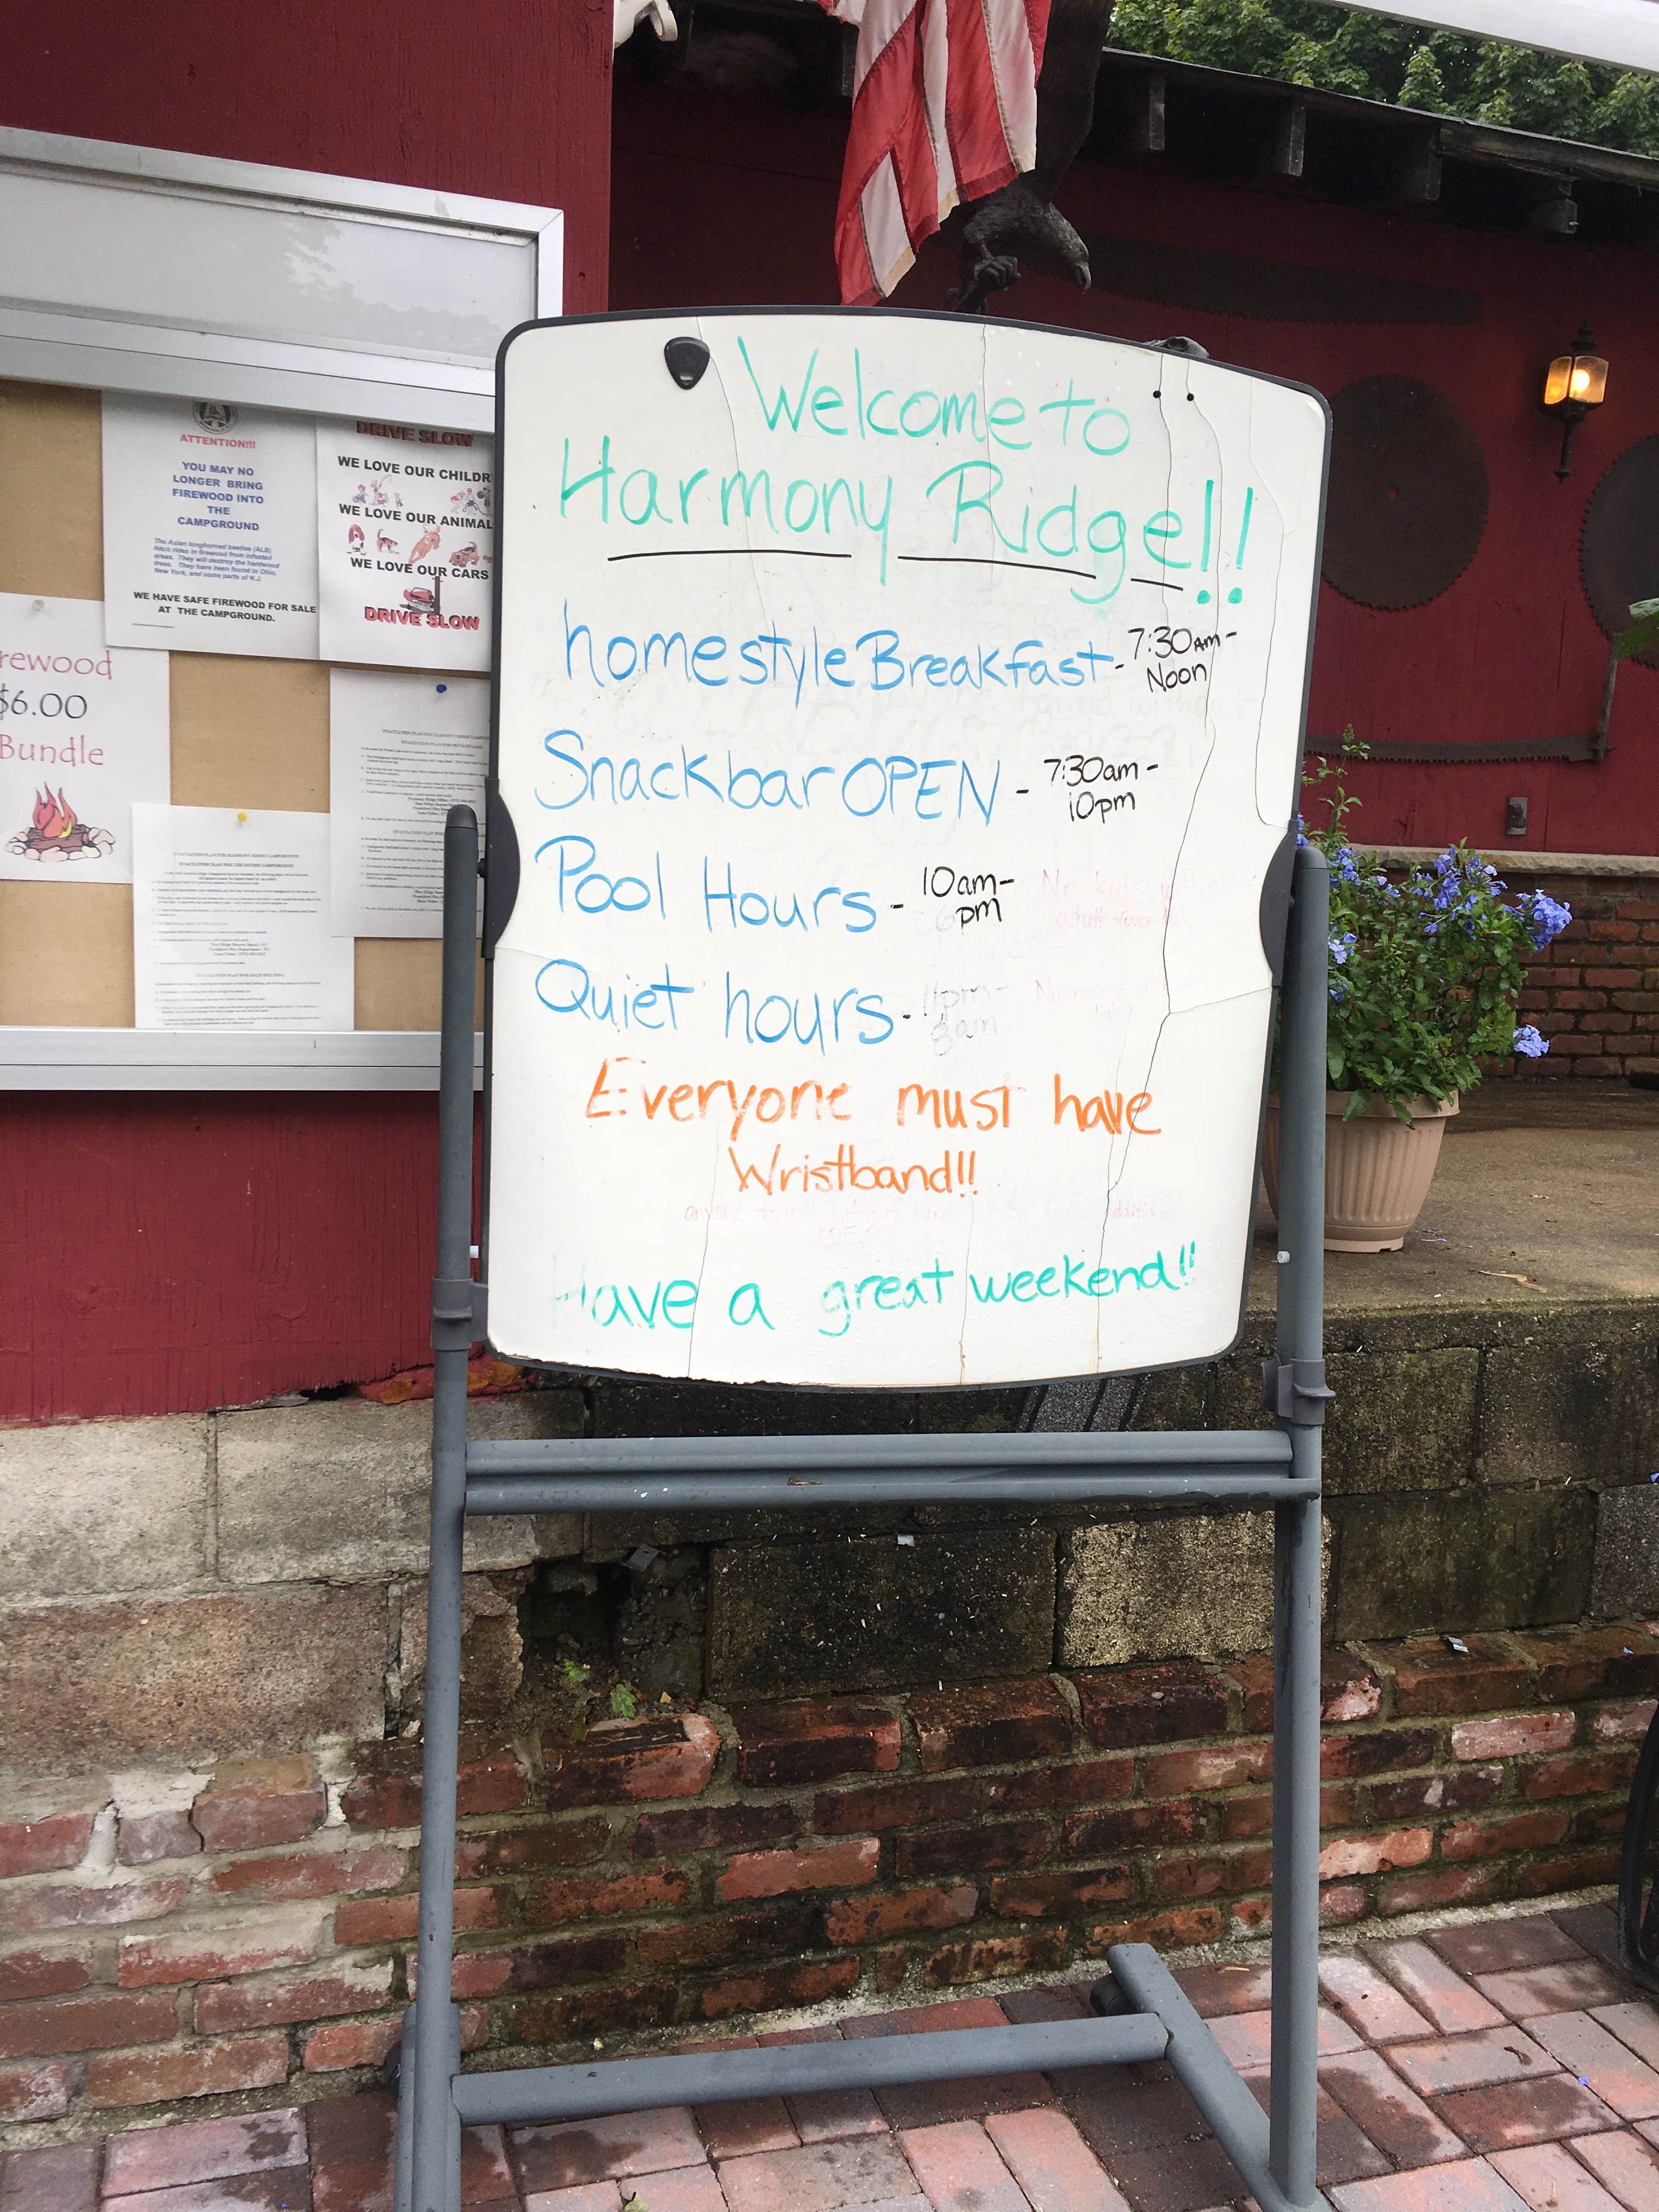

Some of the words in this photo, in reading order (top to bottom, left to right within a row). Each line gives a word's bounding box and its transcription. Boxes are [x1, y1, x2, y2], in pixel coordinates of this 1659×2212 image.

[737, 335, 1032, 450] Welcome
[1040, 379, 1130, 455] to
[179, 433, 256, 449] ATTENTION!!!
[357, 421, 415, 441] DRIVE
[419, 430, 475, 447] SLOW
[182, 461, 206, 472] YOU
[210, 464, 234, 475] MAY
[238, 467, 254, 476] NO
[337, 455, 359, 468] WE
[364, 459, 400, 474] LOVE
[404, 465, 435, 478] OUR
[439, 469, 493, 483] CHILDR
[173, 475, 220, 487] LONGER
[227, 479, 263, 490] BRING
[172, 489, 233, 502] FIREWOOD
[237, 494, 264, 504] INTO
[177, 517, 259, 531] CAMPGROUND
[207, 506, 230, 515] THE
[339, 503, 360, 516] WE
[365, 507, 401, 521] LOVE
[406, 512, 436, 524] OUR
[561, 435, 893, 586] Harmony
[926, 460, 1254, 605] Ridge!!
[351, 557, 372, 569] WE
[377, 561, 413, 574] LOVE
[417, 565, 448, 577] OUR
[452, 568, 489, 580] CARS
[153, 593, 180, 602] HAVE
[183, 596, 210, 605] SAFE
[212, 598, 266, 610] FIREWOOD
[268, 602, 289, 611] FOR
[291, 605, 317, 613] SALE
[201, 609, 275, 622] CAMPGROUND.
[364, 606, 422, 627] DRIVE
[426, 613, 480, 630] SLOW
[1147, 661, 1207, 693] Noon
[0, 734, 104, 767] Bundle
[842, 756, 1000, 827] OPEN
[1069, 791, 1136, 824] 10pm
[535, 835, 665, 920] Pool
[535, 959, 694, 1031] Quiet
[585, 1057, 852, 1142] Everyone
[896, 1071, 1026, 1131] must
[1054, 1074, 1162, 1135] have
[728, 1143, 978, 1198] Wristband!!
[729, 1282, 775, 1330] a
[819, 1258, 954, 1337] great
[969, 1240, 1195, 1304] weekend!!
